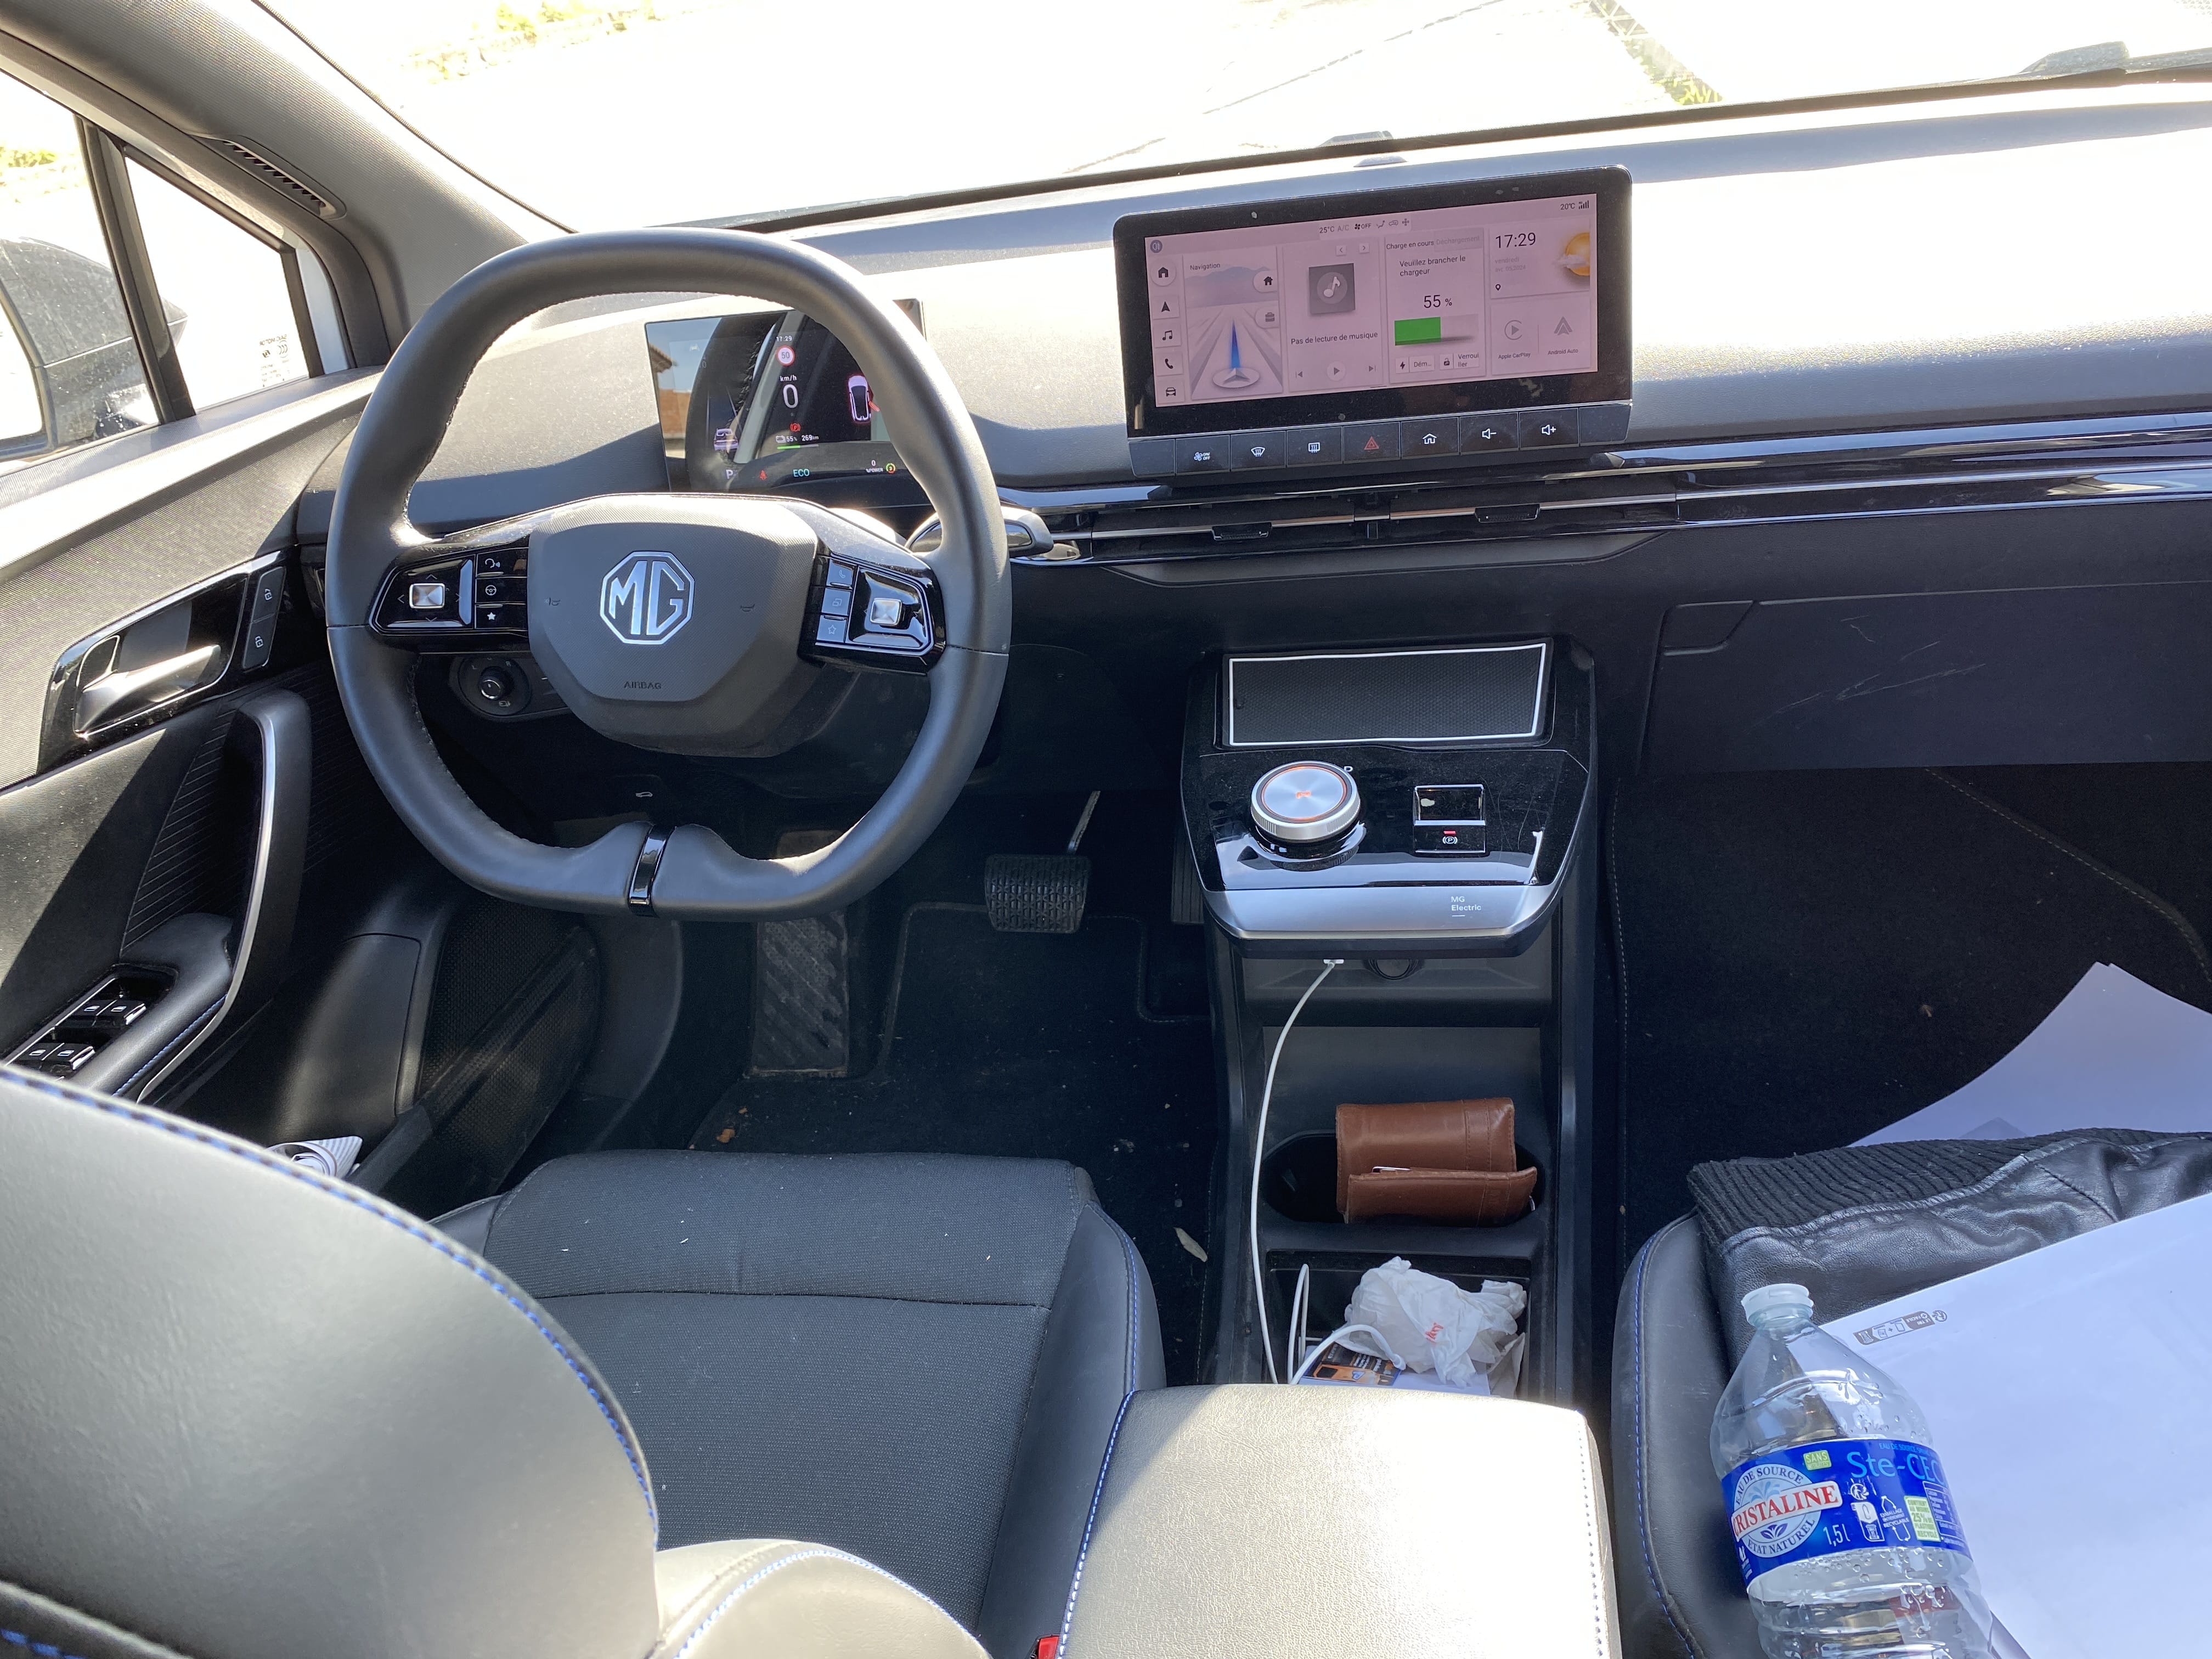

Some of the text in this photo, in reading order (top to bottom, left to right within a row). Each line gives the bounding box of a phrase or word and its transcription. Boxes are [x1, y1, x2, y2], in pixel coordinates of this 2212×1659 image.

[1496, 232, 1536, 248] 17:29
[1189, 262, 1221, 271] Navigation
[1400, 259, 1426, 267] Veuillez
[1427, 256, 1457, 265] brancher
[1424, 295, 1441, 308] 55
[1314, 335, 1338, 343] lecture
[1348, 331, 1378, 340] musique
[783, 384, 799, 408] 0
[725, 470, 733, 479] P
[793, 469, 810, 477] ECO
[608, 560, 685, 636] MG
[624, 681, 662, 690] AIRBAG
[1805, 1451, 1828, 1464] SANS
[1735, 1466, 1804, 1505] EAU DE SOURCE
[1733, 1485, 1838, 1537] CRISTALINE
[1883, 1517, 1910, 1528] RECYCLABLE
[1911, 1512, 1928, 1523] 25%
[1748, 1519, 1816, 1554] ETAT NATUREL
